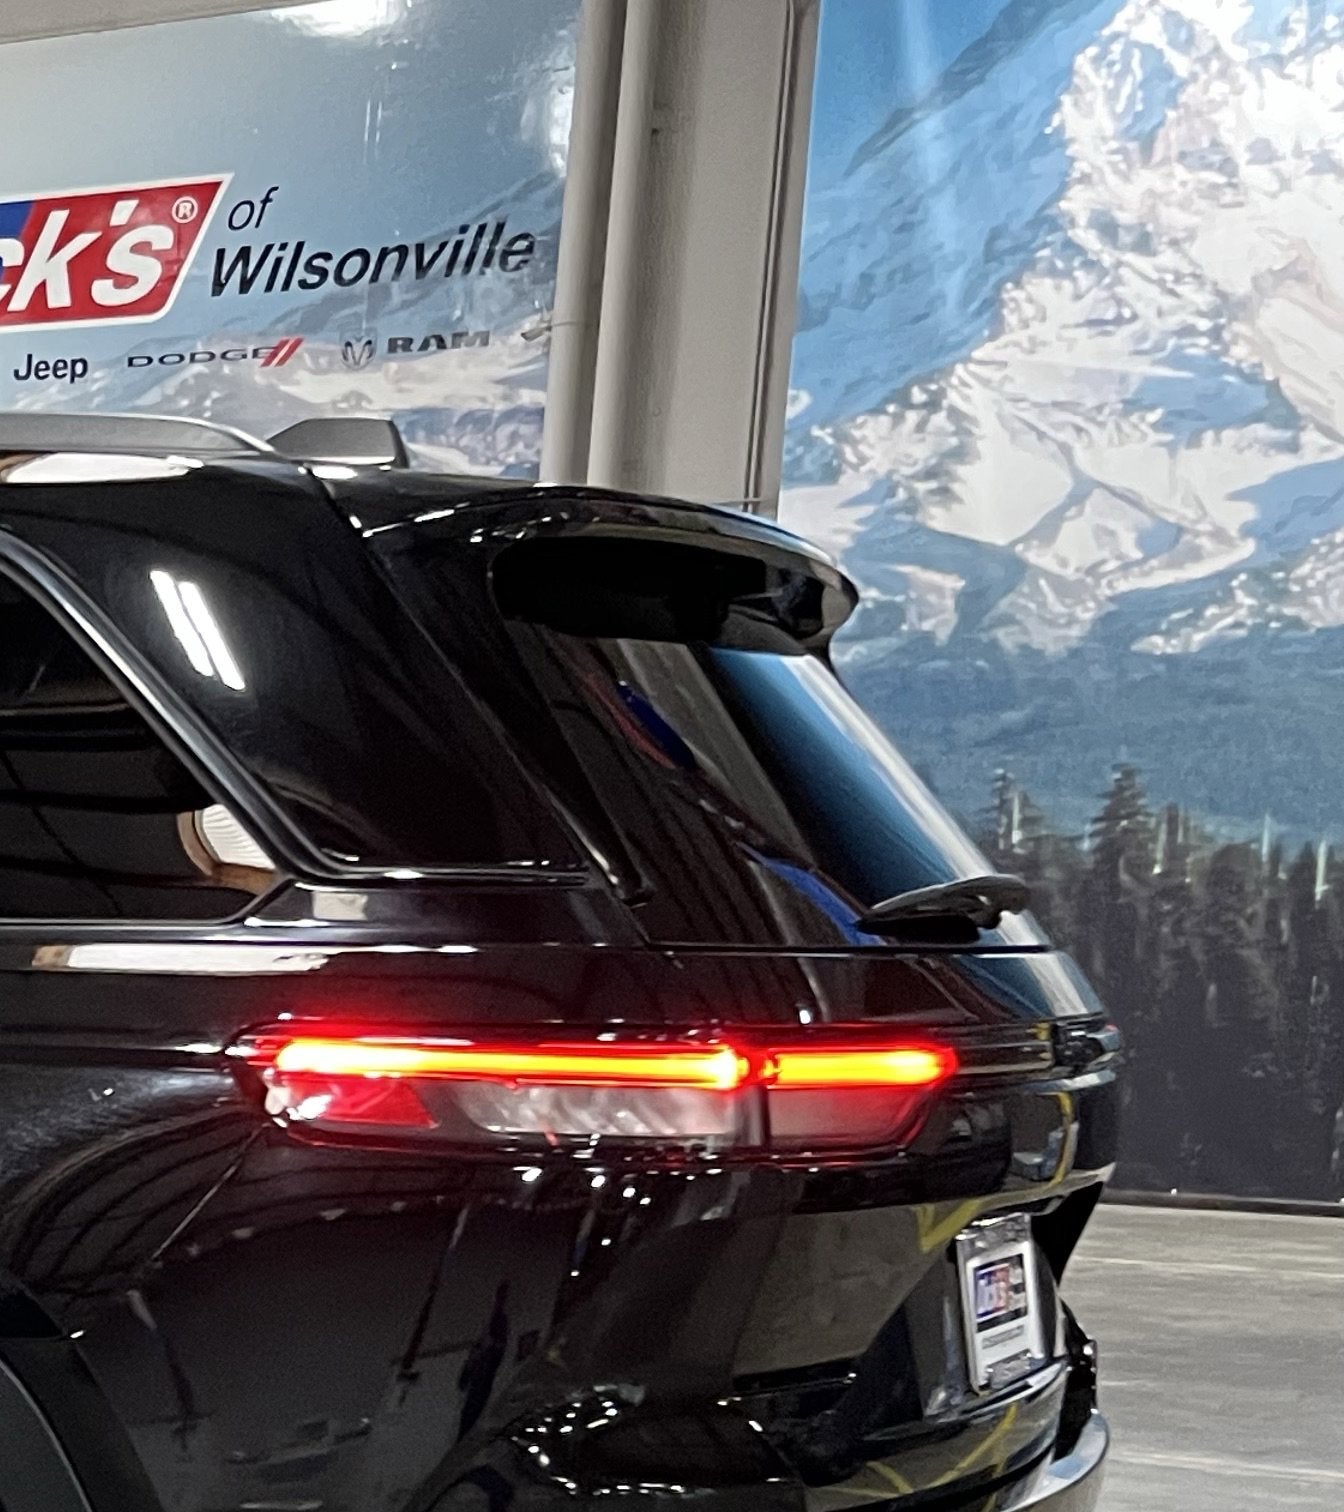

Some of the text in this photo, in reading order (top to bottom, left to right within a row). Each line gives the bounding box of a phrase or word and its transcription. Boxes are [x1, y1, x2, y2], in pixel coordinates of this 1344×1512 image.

[227, 186, 279, 231] of
[211, 220, 535, 298] Wilsonville
[13, 330, 491, 384] Jeep DODGE RAM
